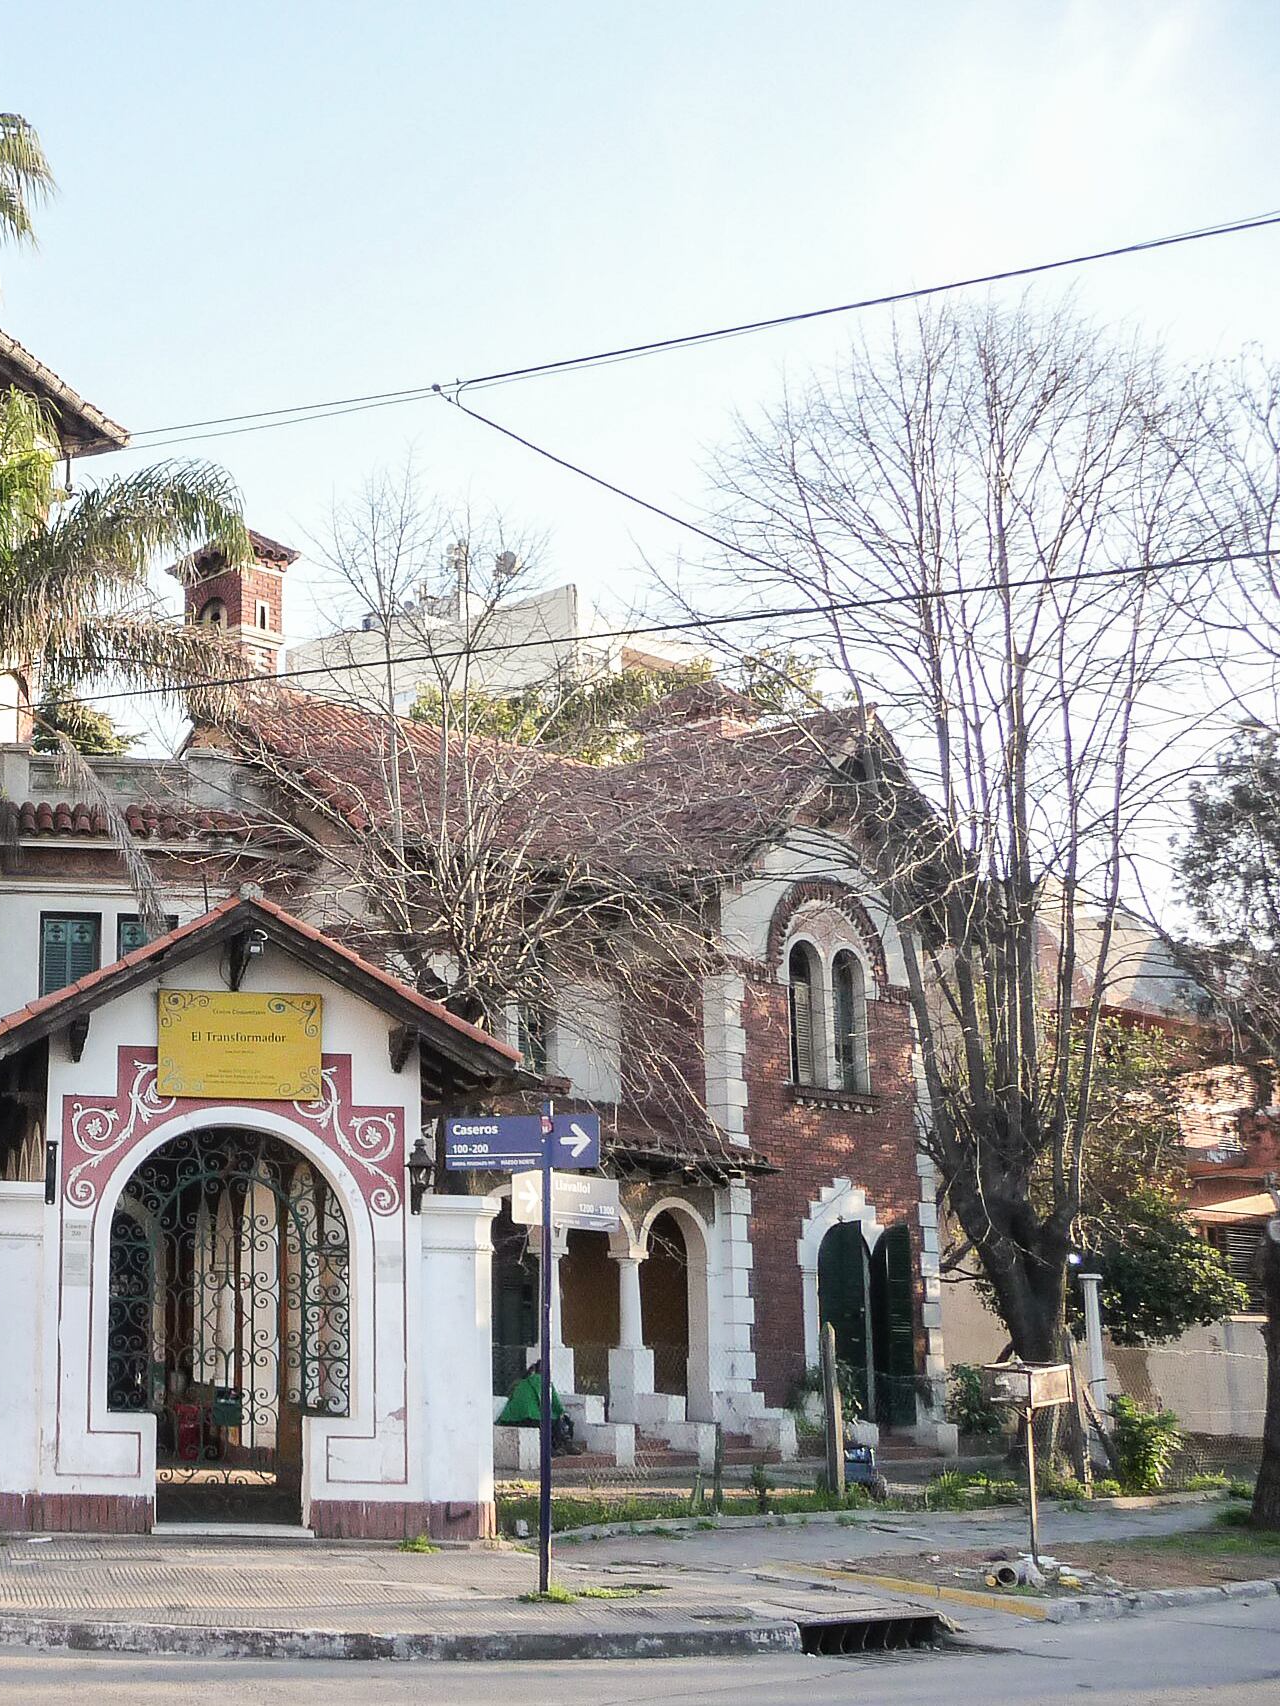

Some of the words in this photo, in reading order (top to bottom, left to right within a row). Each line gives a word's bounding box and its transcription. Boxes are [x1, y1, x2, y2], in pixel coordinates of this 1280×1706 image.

[191, 1031, 201, 1042] El
[205, 1031, 287, 1043] Transformador
[452, 1124, 498, 1135] Caseros
[555, 1179, 591, 1194] Llavallol
